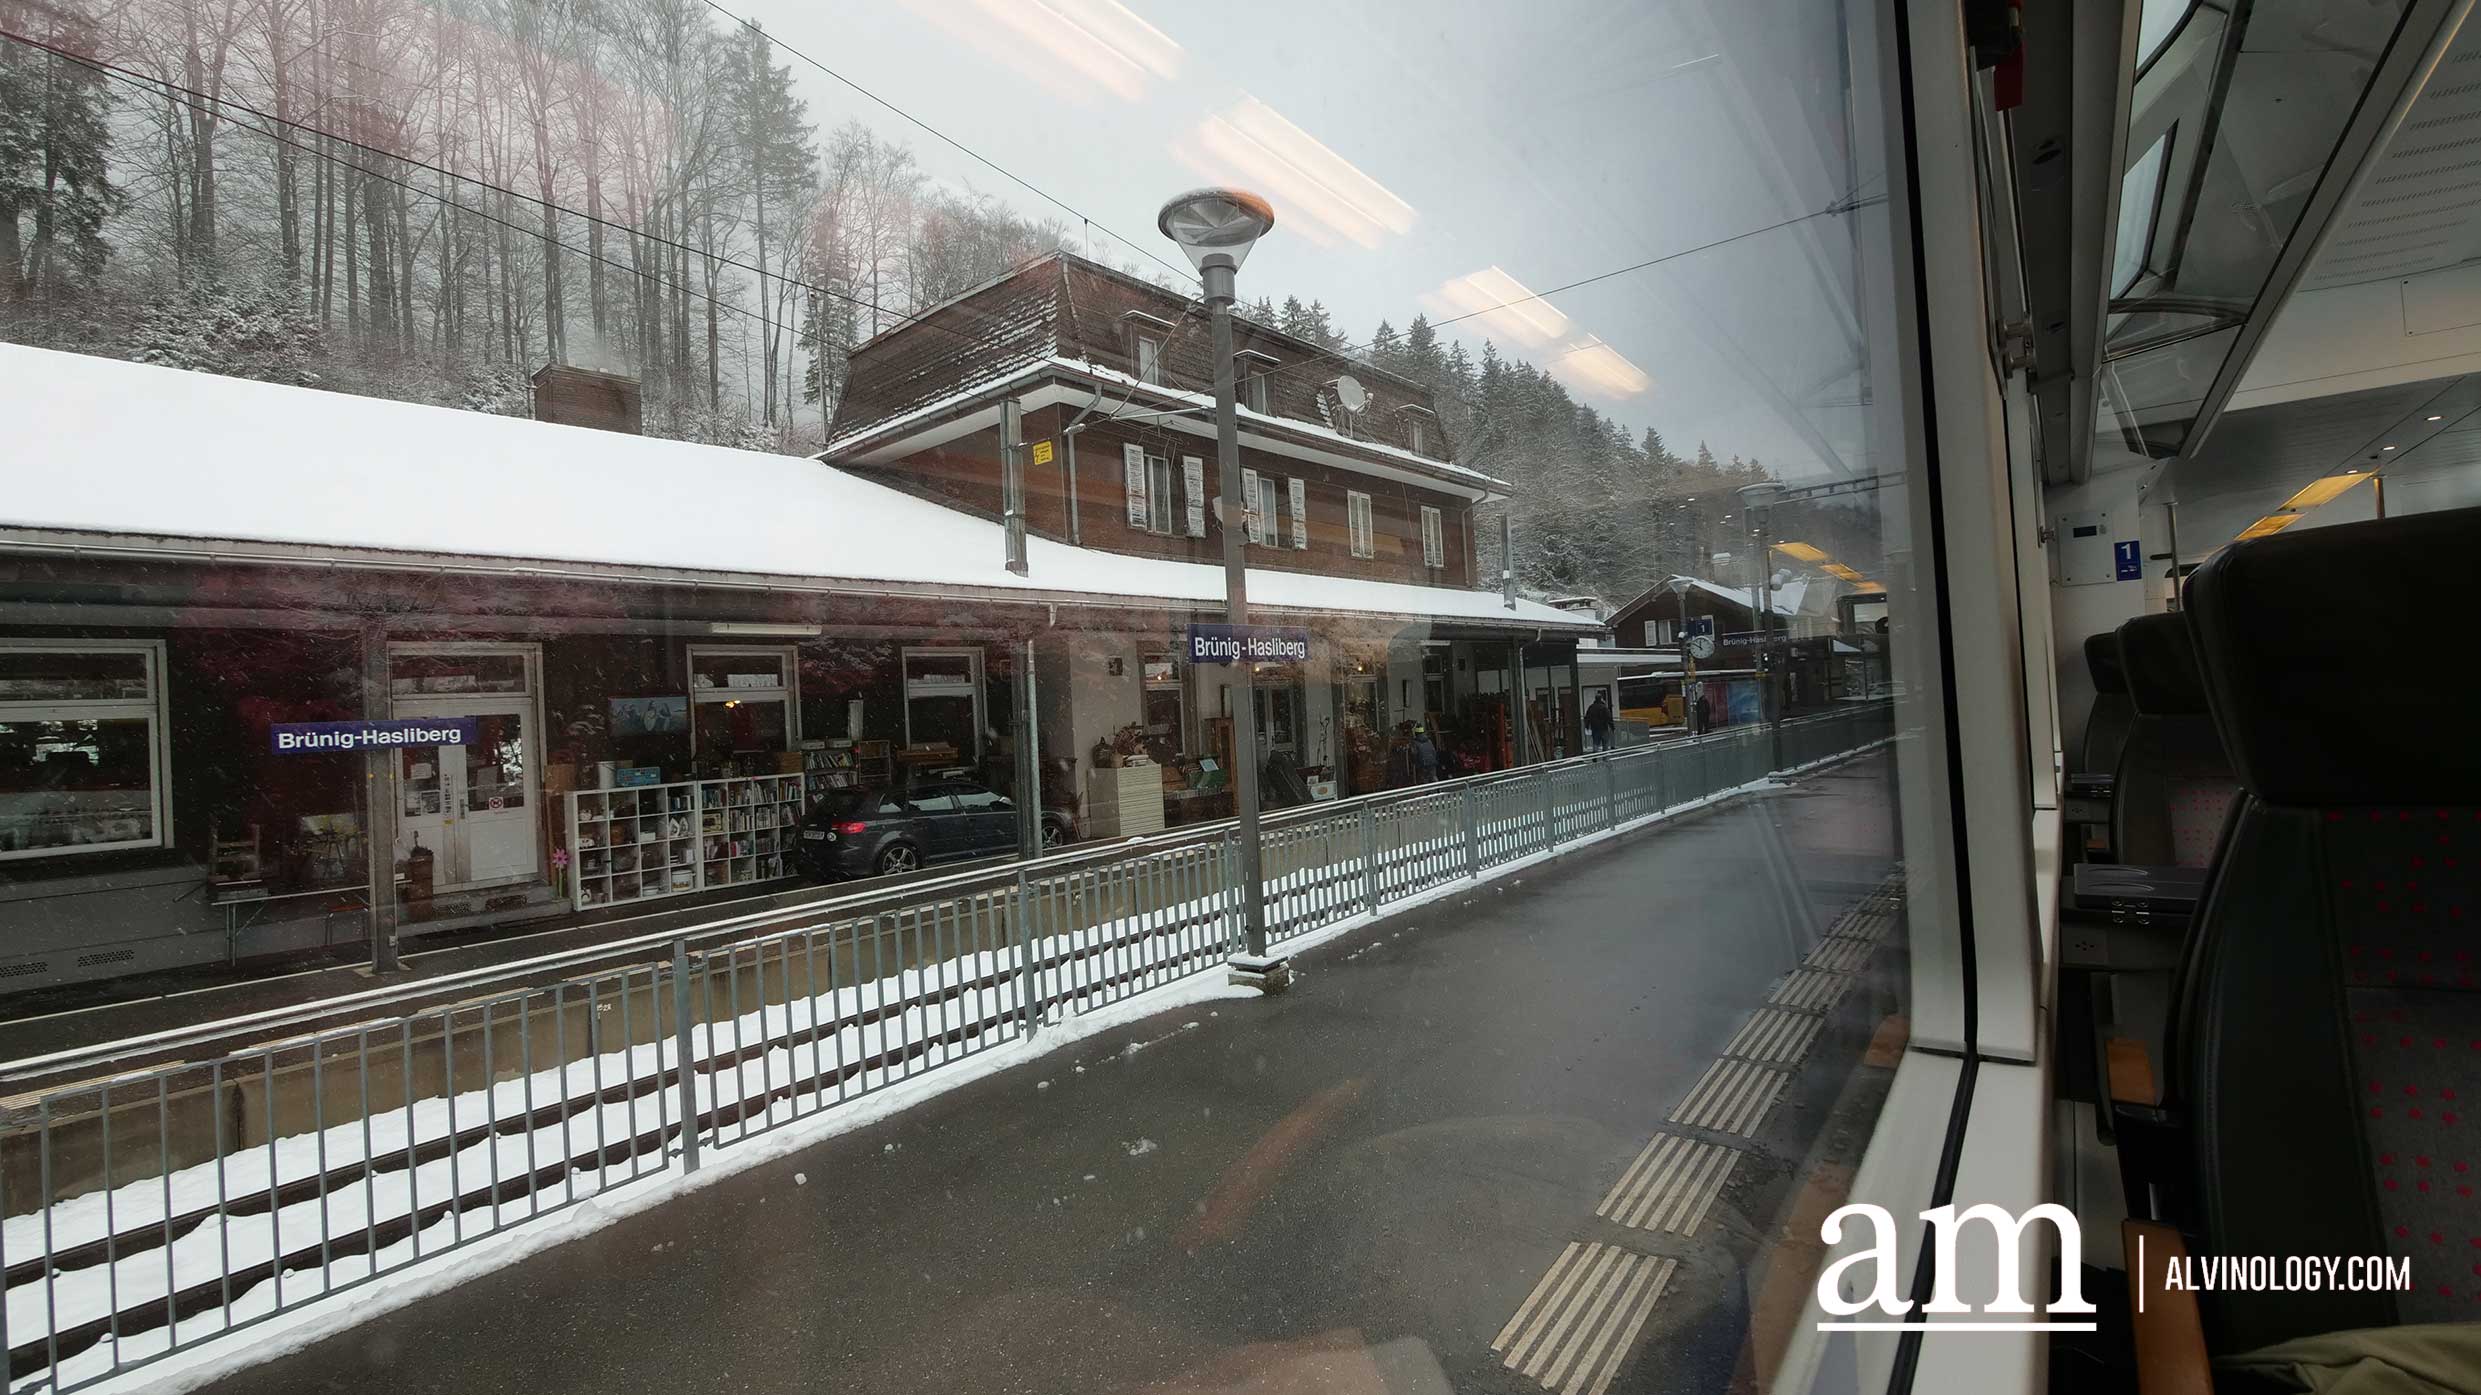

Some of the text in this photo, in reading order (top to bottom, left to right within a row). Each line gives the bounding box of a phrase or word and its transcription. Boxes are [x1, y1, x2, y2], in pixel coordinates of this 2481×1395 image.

[2121, 543, 2131, 560] 1
[1194, 637, 1305, 660] Brünig-Hasliberg
[278, 728, 461, 749] Brünig-Hasliberg
